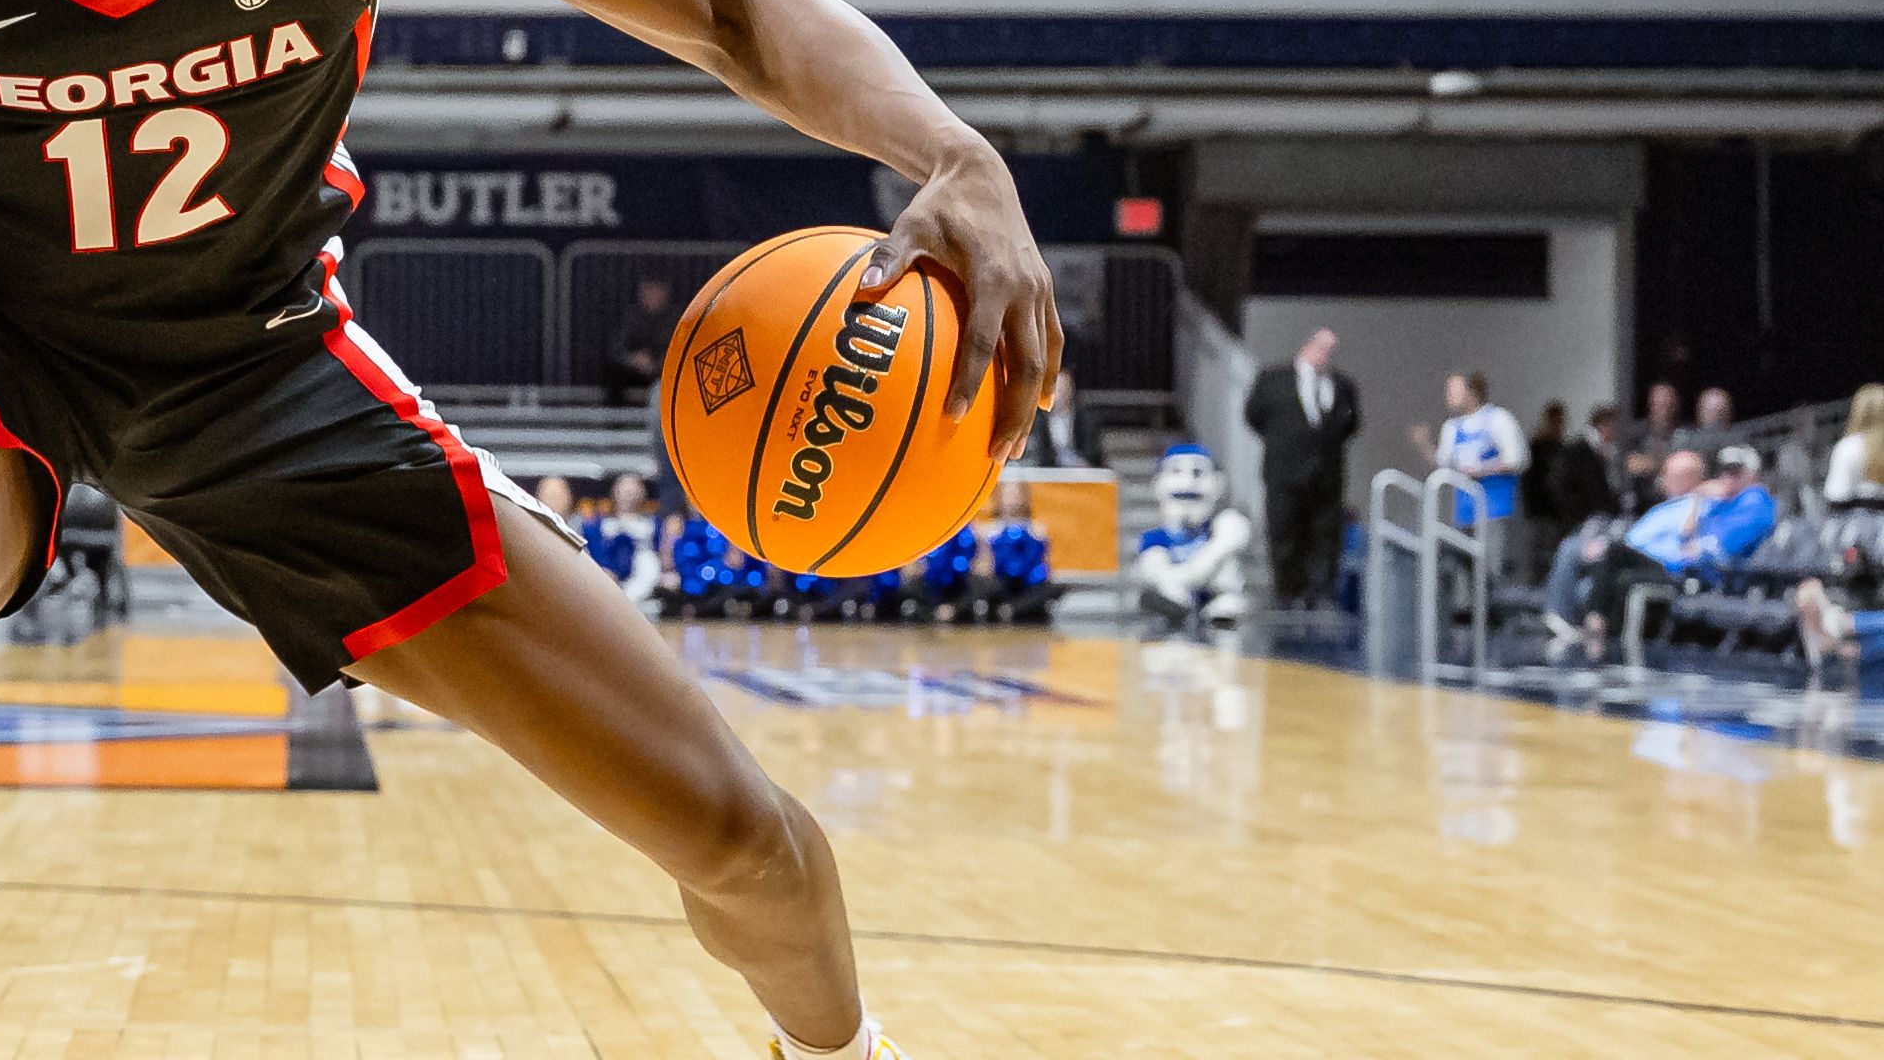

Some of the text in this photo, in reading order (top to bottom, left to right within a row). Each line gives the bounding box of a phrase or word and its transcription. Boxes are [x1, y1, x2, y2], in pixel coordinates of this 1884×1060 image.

[43, 106, 235, 255] 12
[371, 170, 620, 227] BUTLER
[710, 346, 736, 397] NIT
[786, 368, 819, 441] EVO NXT
[772, 300, 911, 522] Wilson
